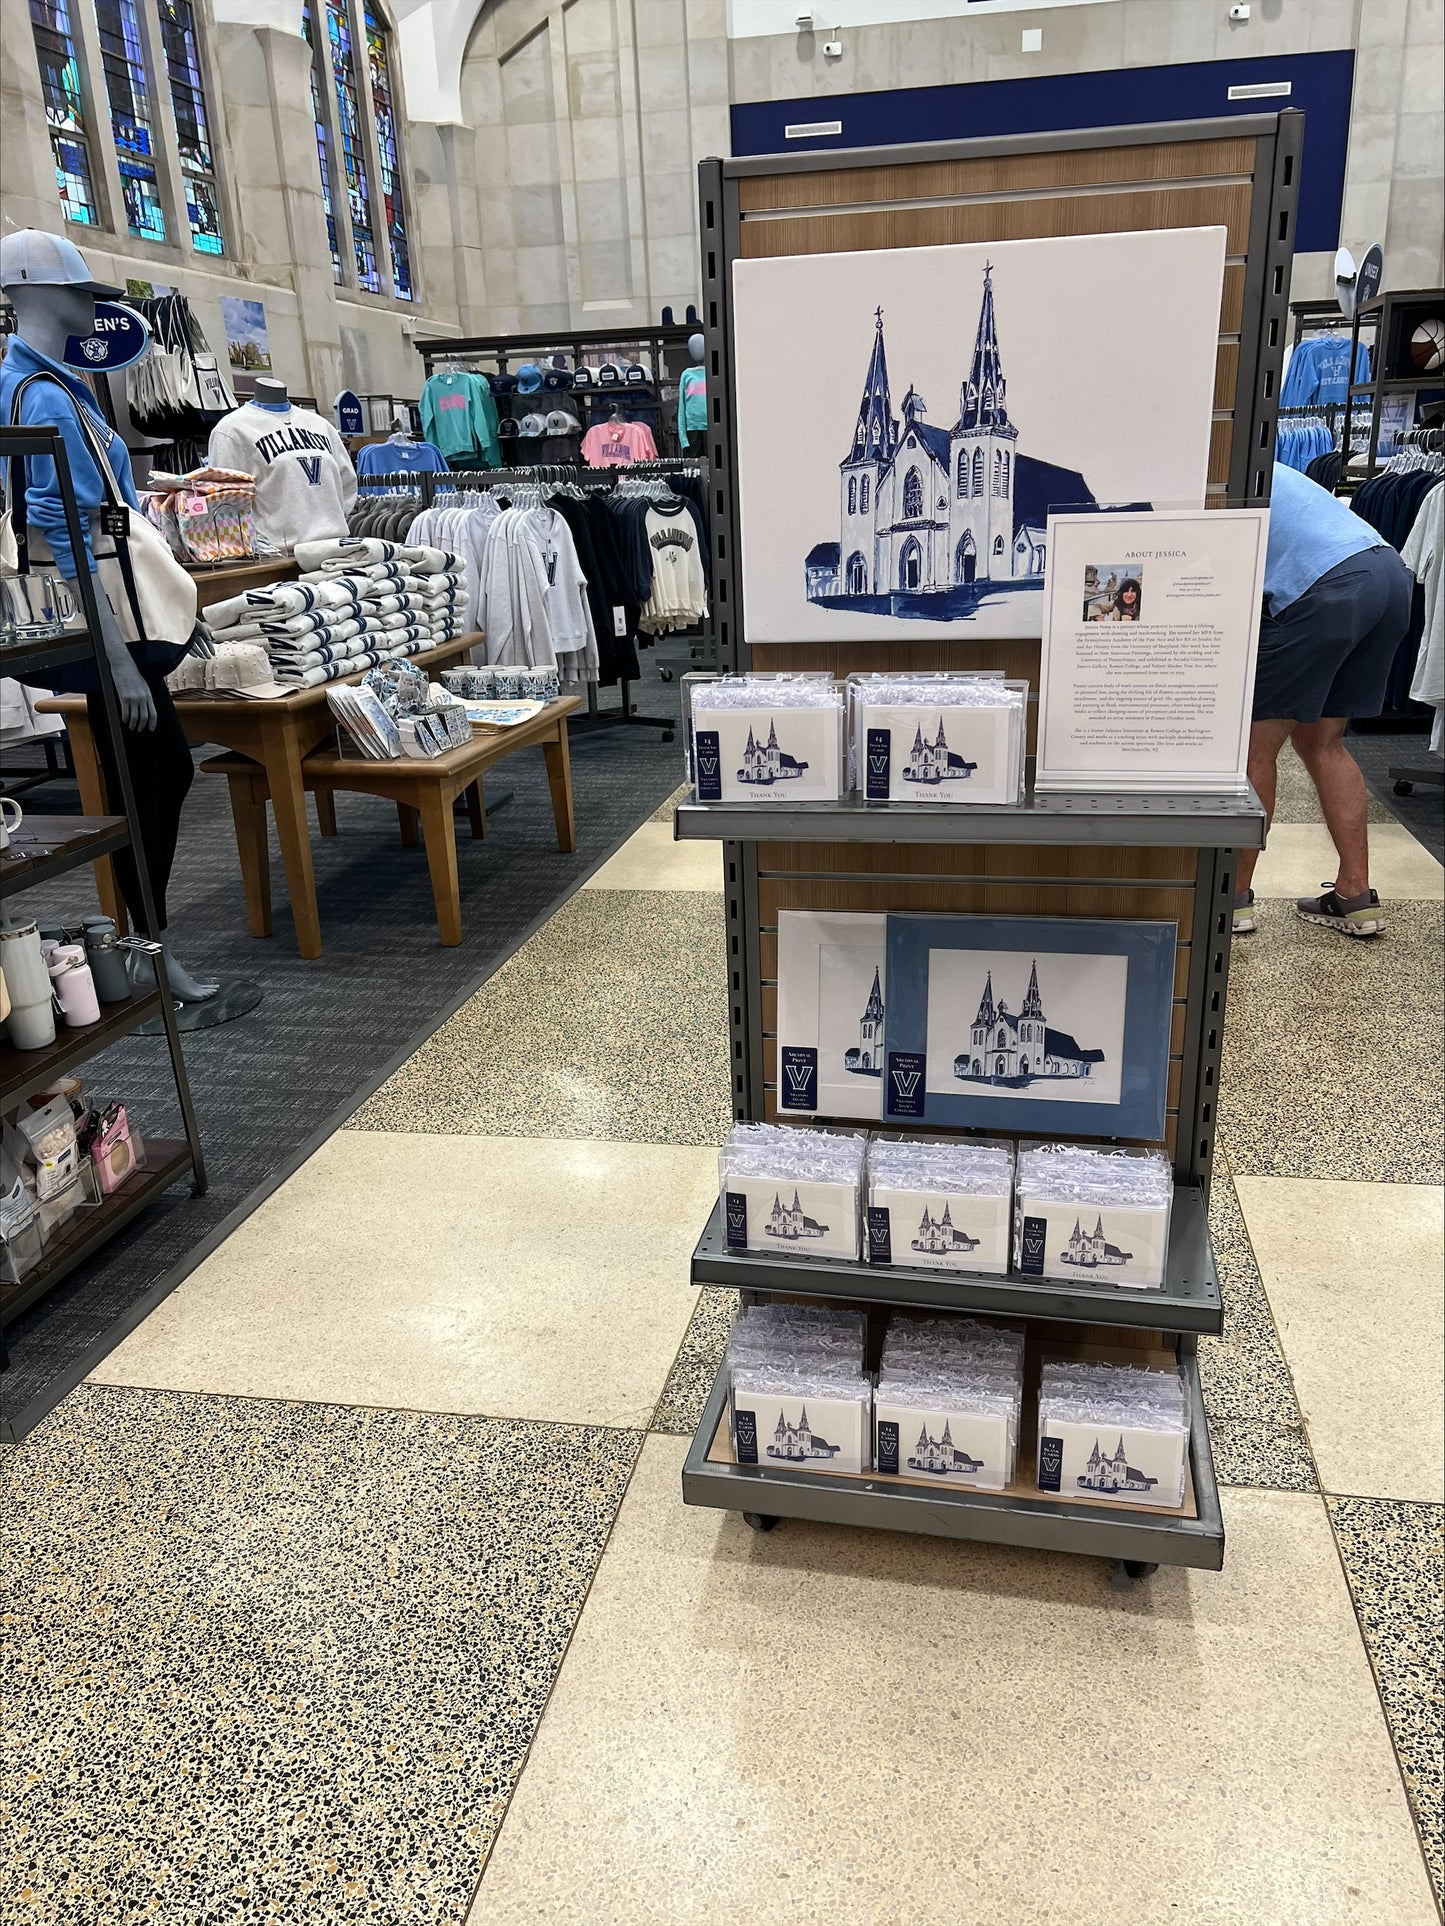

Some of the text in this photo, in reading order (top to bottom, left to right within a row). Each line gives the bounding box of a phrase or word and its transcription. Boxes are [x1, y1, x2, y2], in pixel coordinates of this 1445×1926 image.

[94, 318, 130, 332] EN'S
[785, 1065, 813, 1090] V
[892, 1070, 921, 1097] V
